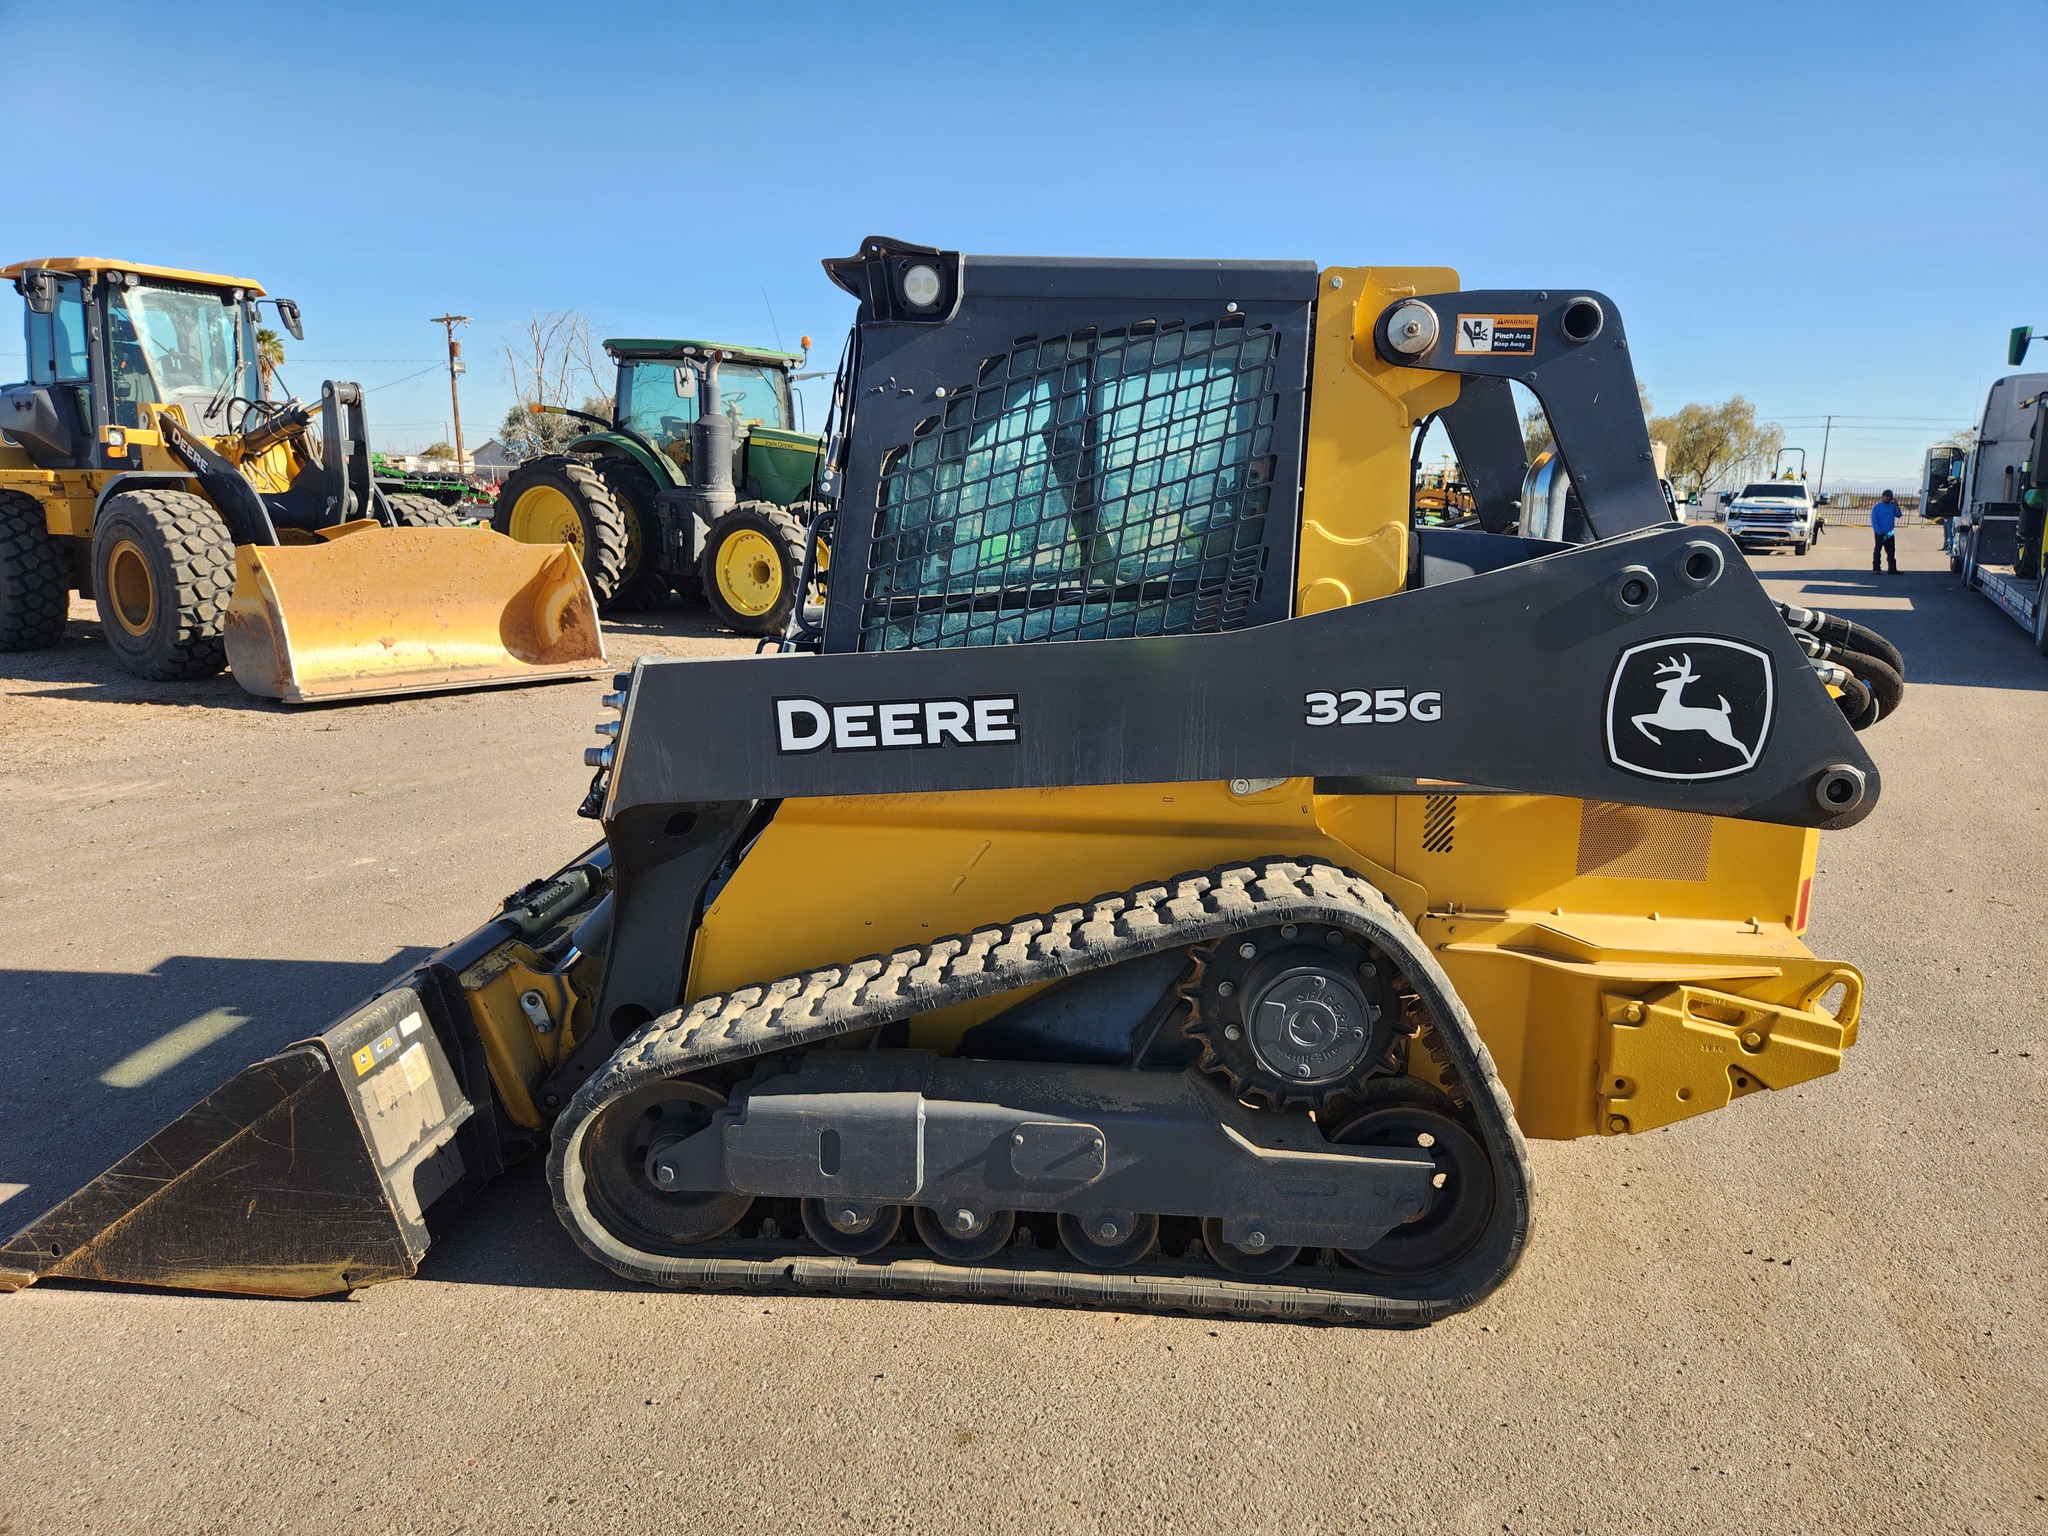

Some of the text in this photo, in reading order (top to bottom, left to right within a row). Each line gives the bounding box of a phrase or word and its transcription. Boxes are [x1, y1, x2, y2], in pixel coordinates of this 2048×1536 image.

[178, 286, 219, 300] DEERE
[171, 427, 209, 474] DEERE
[778, 441, 794, 449] DEERE
[1305, 689, 1442, 726] 325G
[777, 698, 1018, 752] DEERE
[376, 1037, 394, 1054] C78
